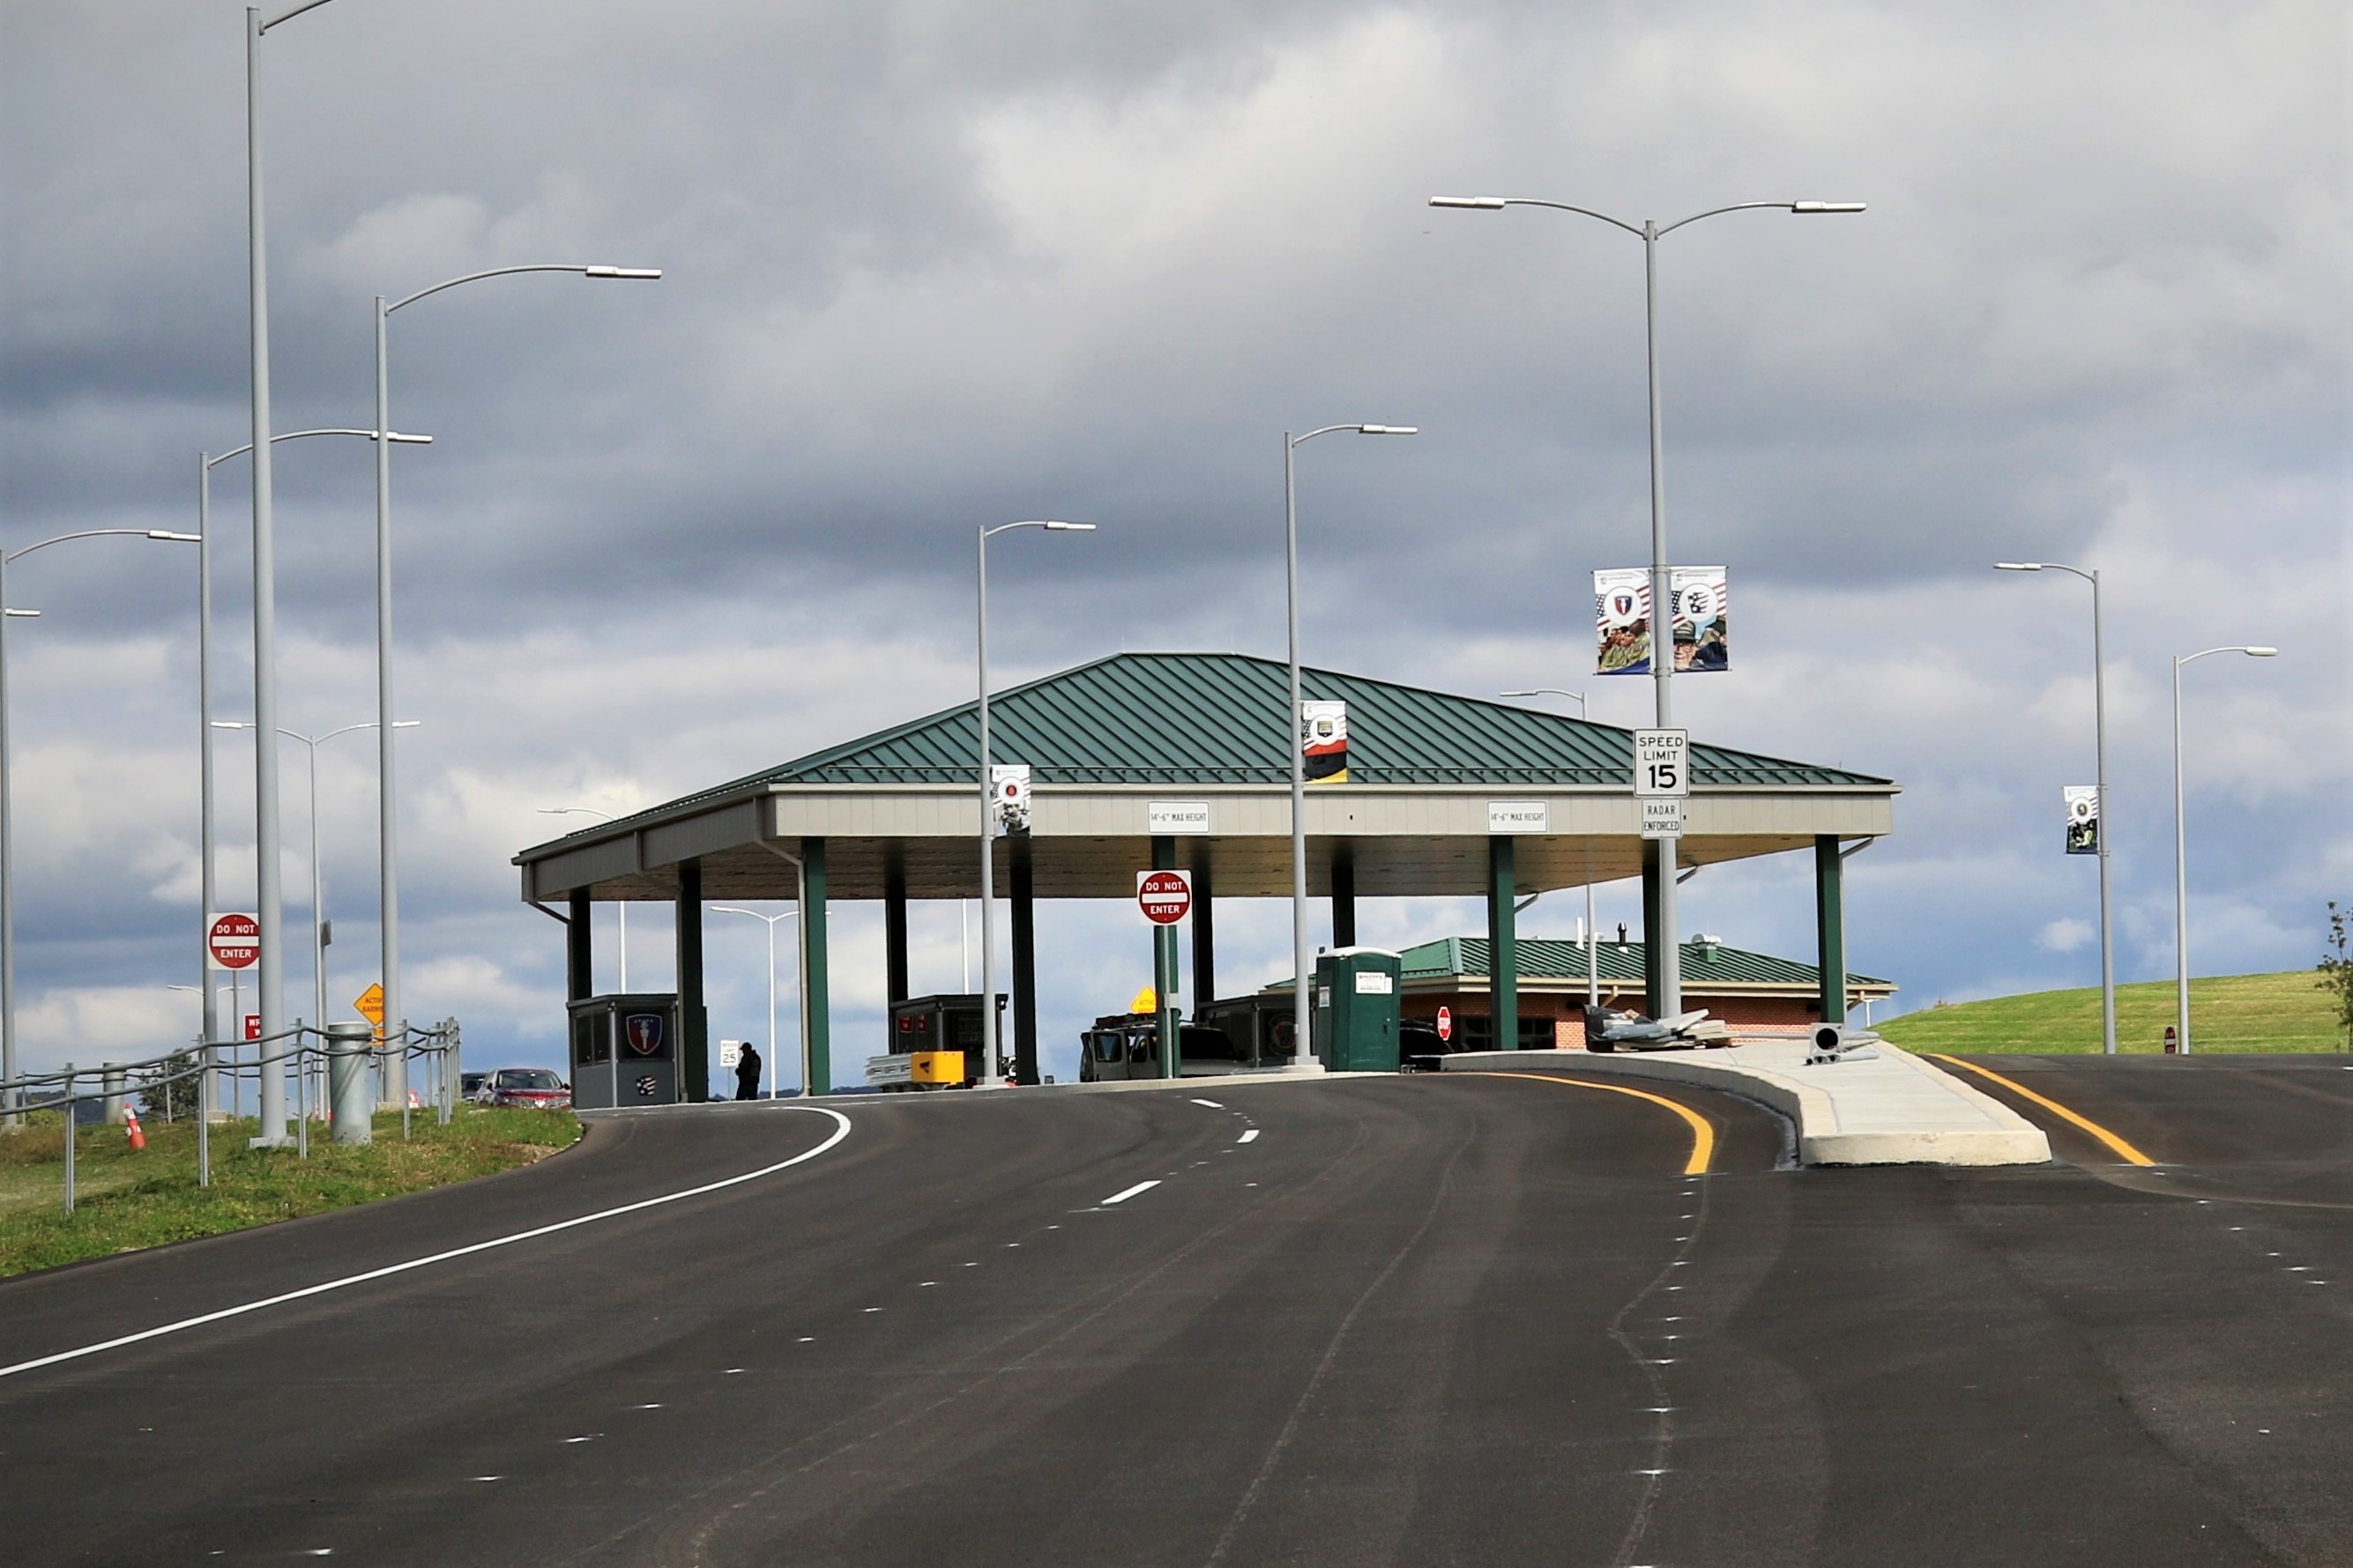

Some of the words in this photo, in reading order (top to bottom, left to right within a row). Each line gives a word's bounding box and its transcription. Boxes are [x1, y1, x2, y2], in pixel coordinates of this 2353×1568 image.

[1639, 737, 1683, 747] SPEED
[1644, 751, 1678, 761] LIMIT
[1649, 764, 1677, 789] 15
[1648, 806, 1675, 815] RADAR
[1172, 813, 1184, 821] MAX
[1186, 813, 1206, 821] HEIGHT
[1510, 813, 1523, 821] MAX
[1524, 813, 1544, 821] HEIGHT
[1644, 821, 1679, 831] ENFORCED
[1145, 881, 1159, 891] DO
[1164, 881, 1182, 890] NOT
[1150, 905, 1180, 914] ENTER
[216, 924, 230, 934] DO
[235, 924, 255, 934] NOT
[220, 948, 251, 958] ENTER
[723, 1053, 736, 1063] 25
